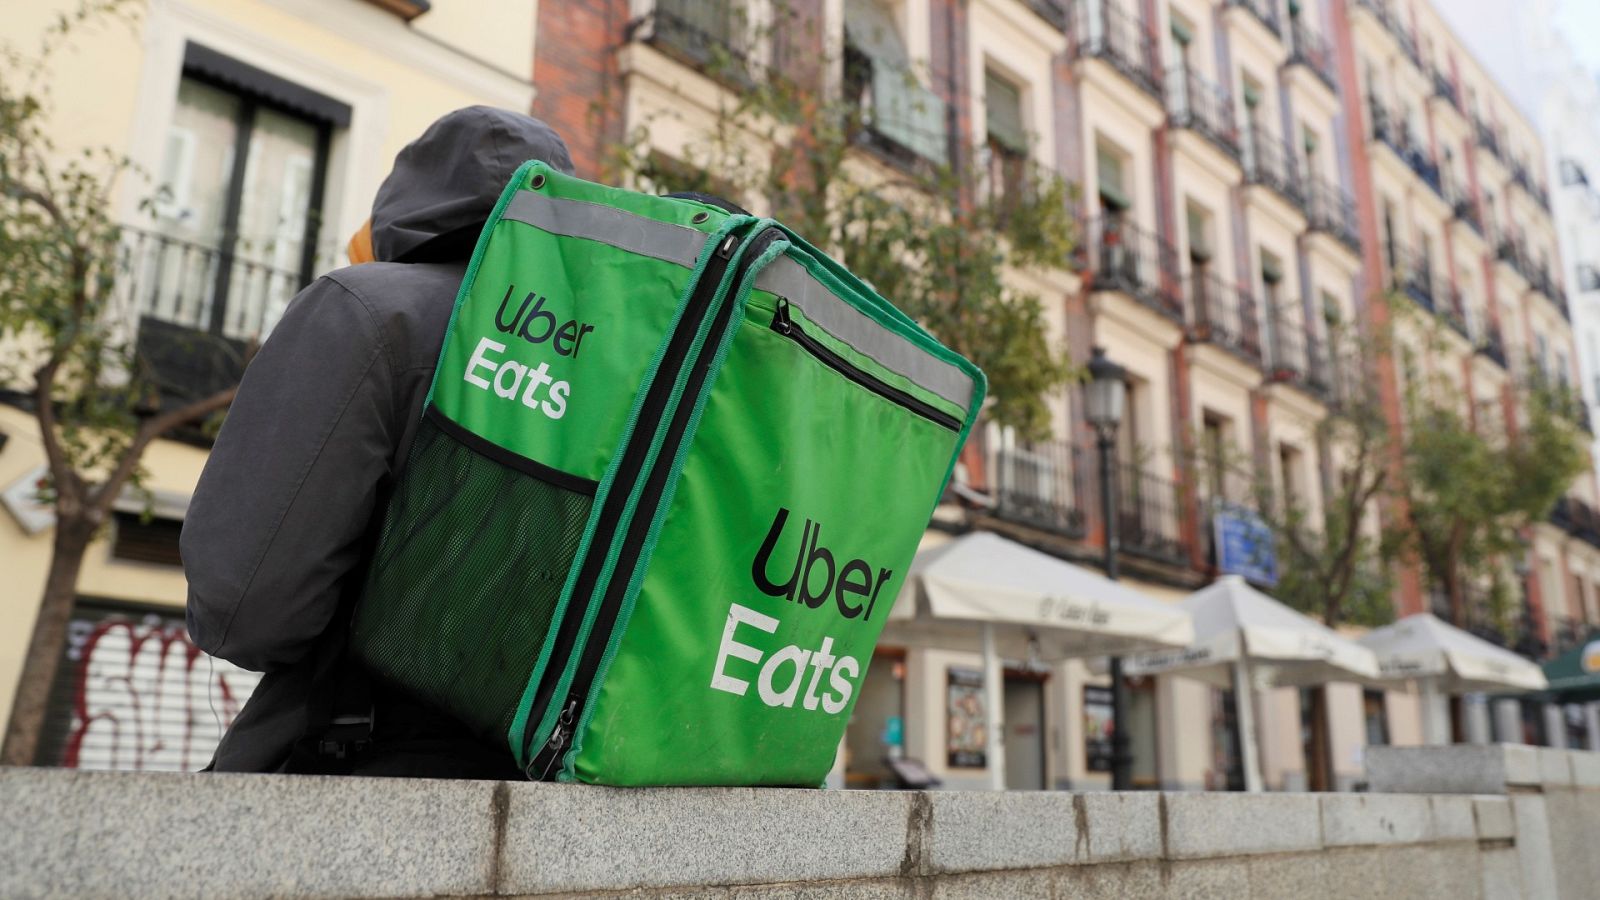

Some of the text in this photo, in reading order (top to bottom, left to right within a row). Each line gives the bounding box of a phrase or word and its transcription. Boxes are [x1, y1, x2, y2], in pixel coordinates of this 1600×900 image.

[495, 284, 595, 359] Uber
[463, 336, 571, 420] Eats
[751, 507, 892, 621] Uber
[710, 603, 860, 714] Eats
